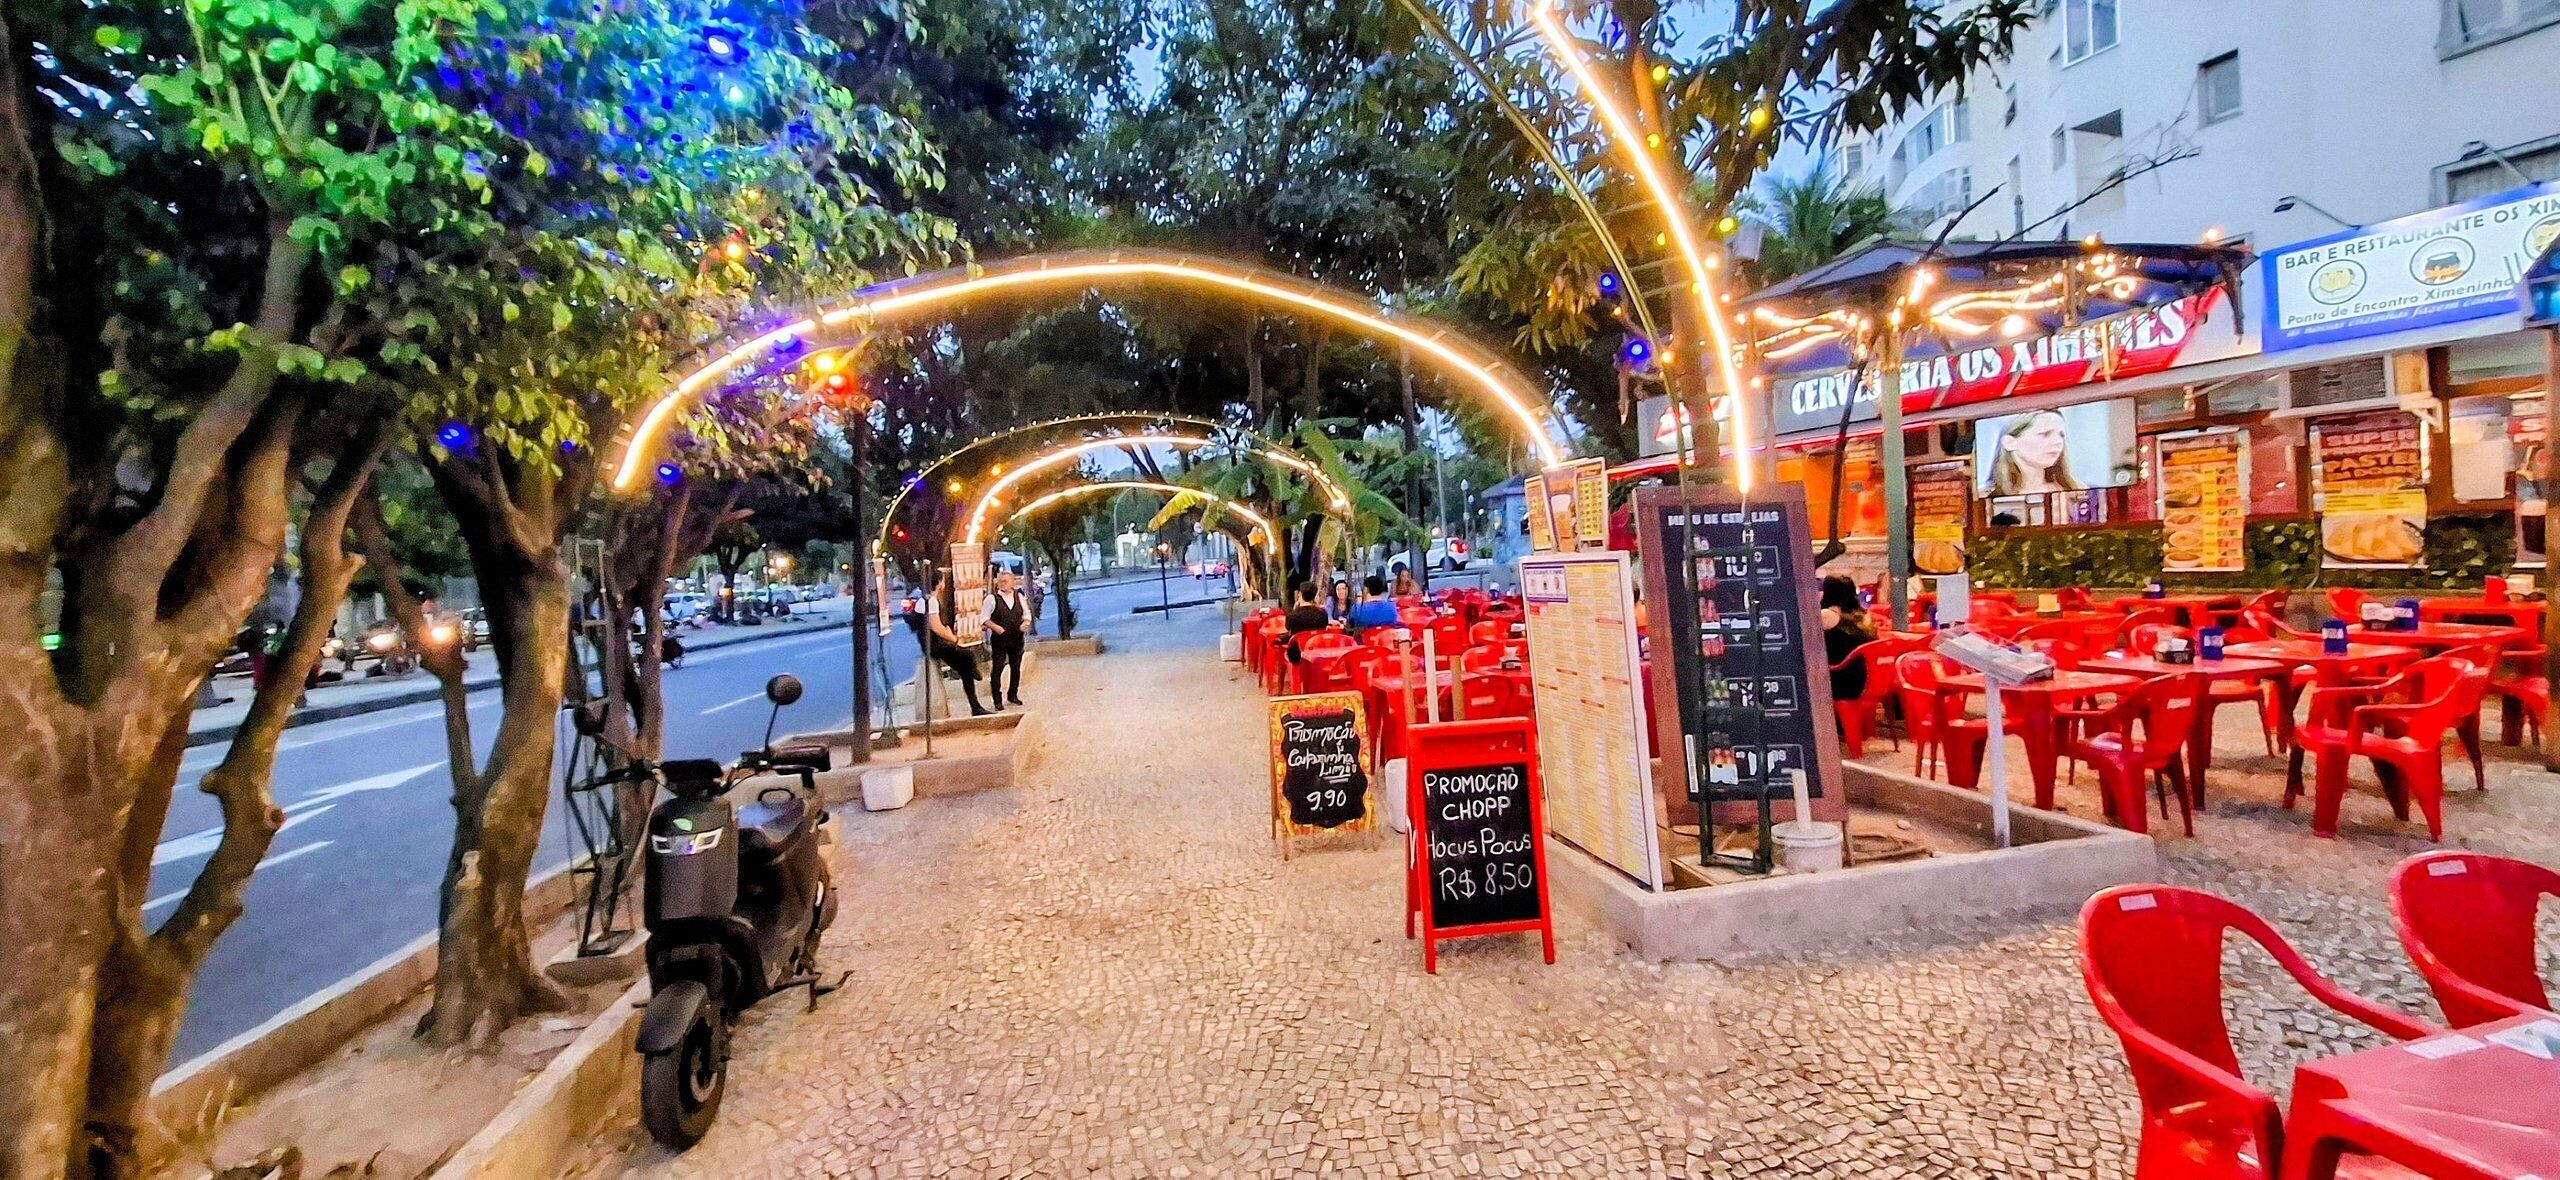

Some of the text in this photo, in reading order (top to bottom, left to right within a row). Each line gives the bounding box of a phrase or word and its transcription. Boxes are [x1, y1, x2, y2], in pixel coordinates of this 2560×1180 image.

[2285, 248, 2320, 269] BAR
[2328, 246, 2338, 260] E
[2344, 213, 2484, 256] RESTAURANTE
[2494, 206, 2518, 223] OS
[2287, 310, 2325, 325] Ponto
[2331, 306, 2349, 317] de
[2353, 294, 2418, 314] Encontro
[1959, 347, 2003, 382] OS
[1668, 514, 1701, 526] MEU
[1424, 766, 1519, 796] PROMOÇÃO
[1442, 795, 1511, 821] CHOPP
[1439, 862, 1532, 901] R$ 8,50
